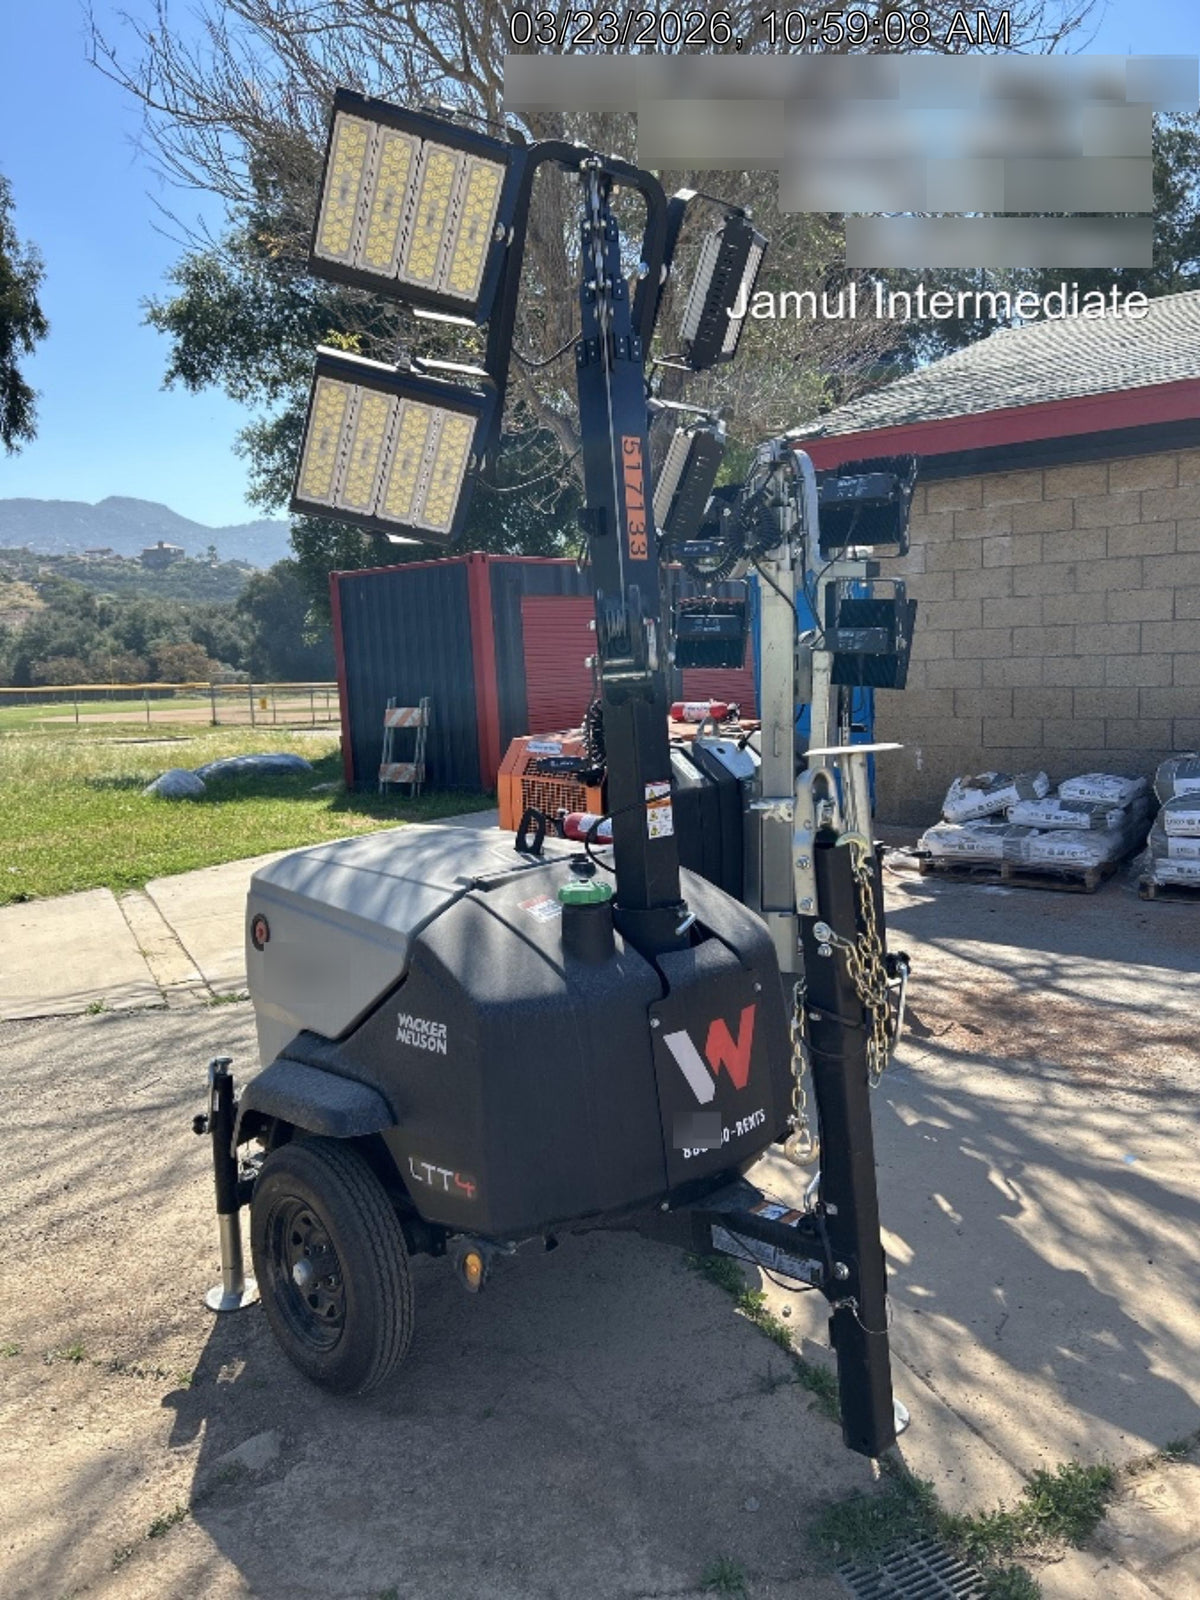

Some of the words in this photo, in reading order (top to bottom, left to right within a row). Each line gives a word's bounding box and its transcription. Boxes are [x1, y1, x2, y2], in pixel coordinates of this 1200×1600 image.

[623, 438, 646, 555] 517133
[396, 1027, 447, 1055] NEUSON
[397, 1012, 447, 1039] WACKER
[408, 1156, 476, 1199] LTT4
